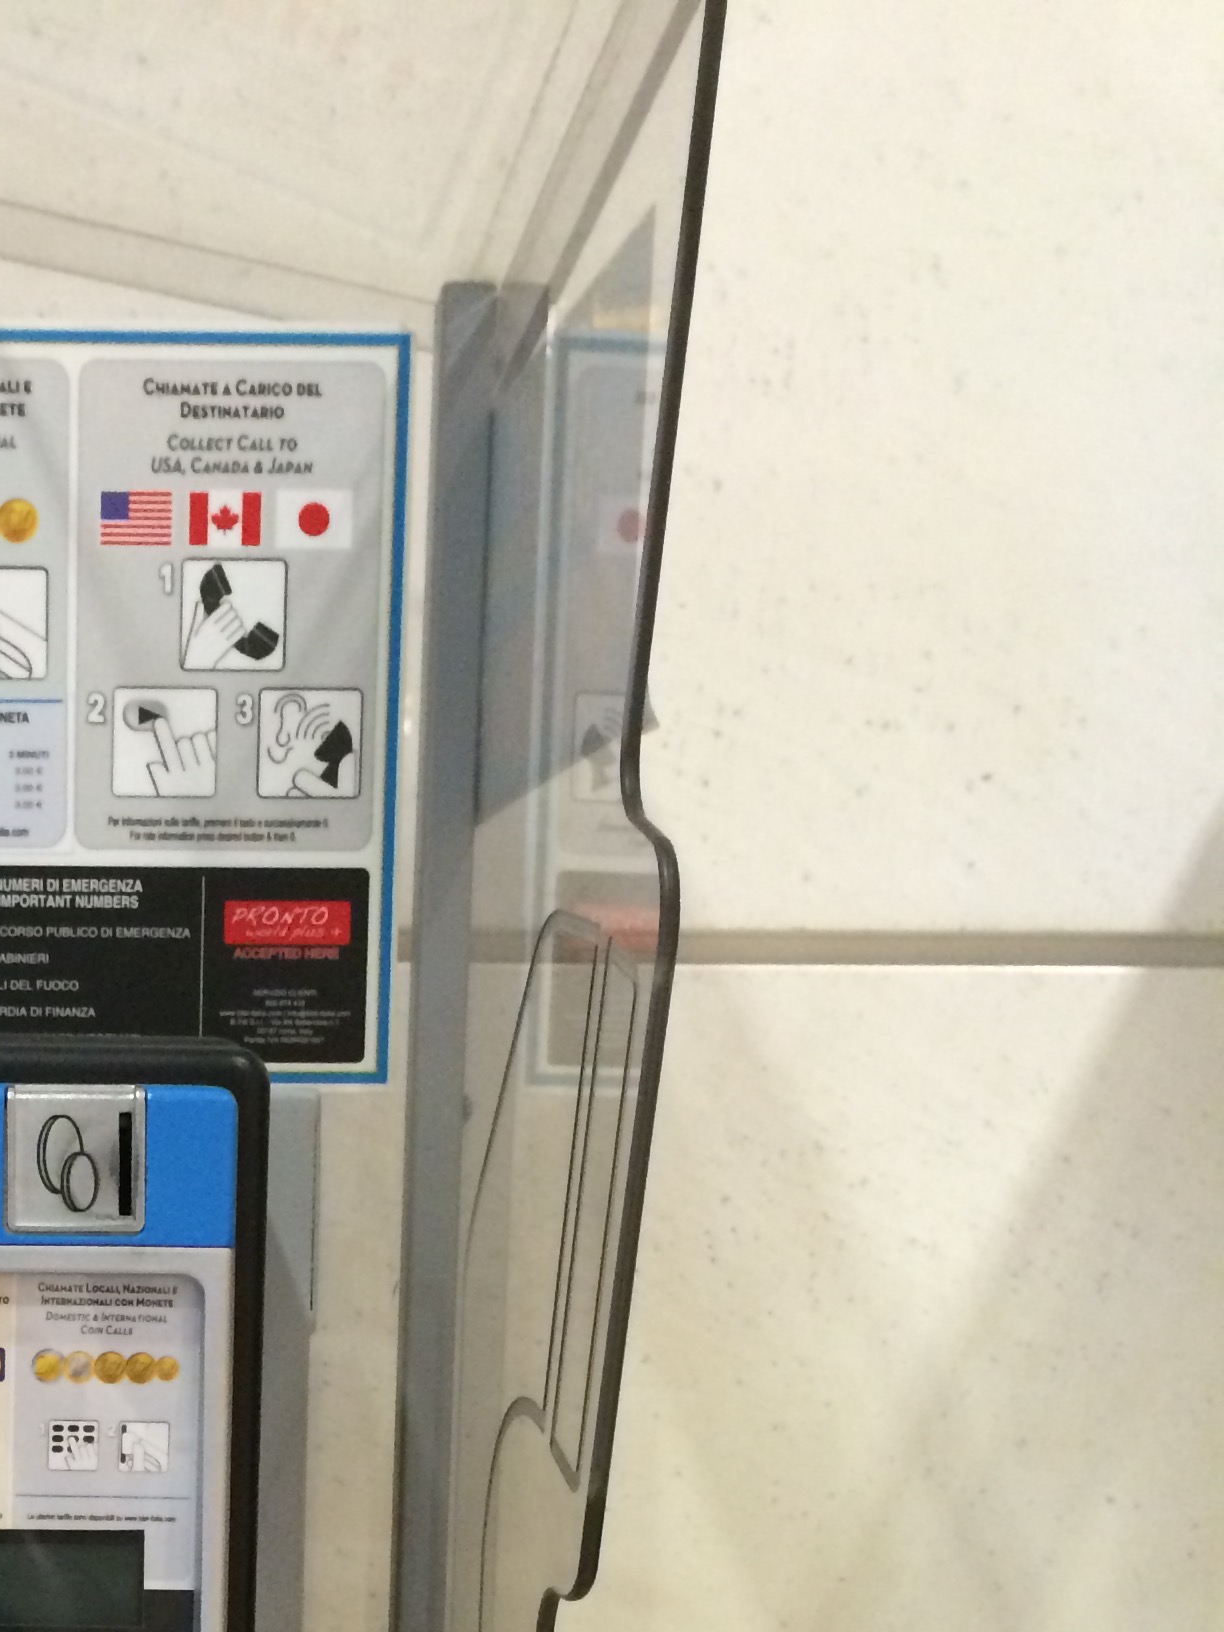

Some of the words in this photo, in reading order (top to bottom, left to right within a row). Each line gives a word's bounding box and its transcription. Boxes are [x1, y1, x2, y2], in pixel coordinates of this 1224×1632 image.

[47, 879, 59, 892] DI
[63, 879, 142, 892] EMERGENZA
[76, 895, 139, 909] NUMBERS
[231, 906, 329, 925] PRONTO
[101, 928, 112, 938] DI
[116, 928, 190, 938] EMERGENZA
[11, 980, 32, 990] DEL
[36, 980, 79, 991] FUOCO
[30, 1007, 42, 1017] DI
[46, 1007, 95, 1017] FINANZA
